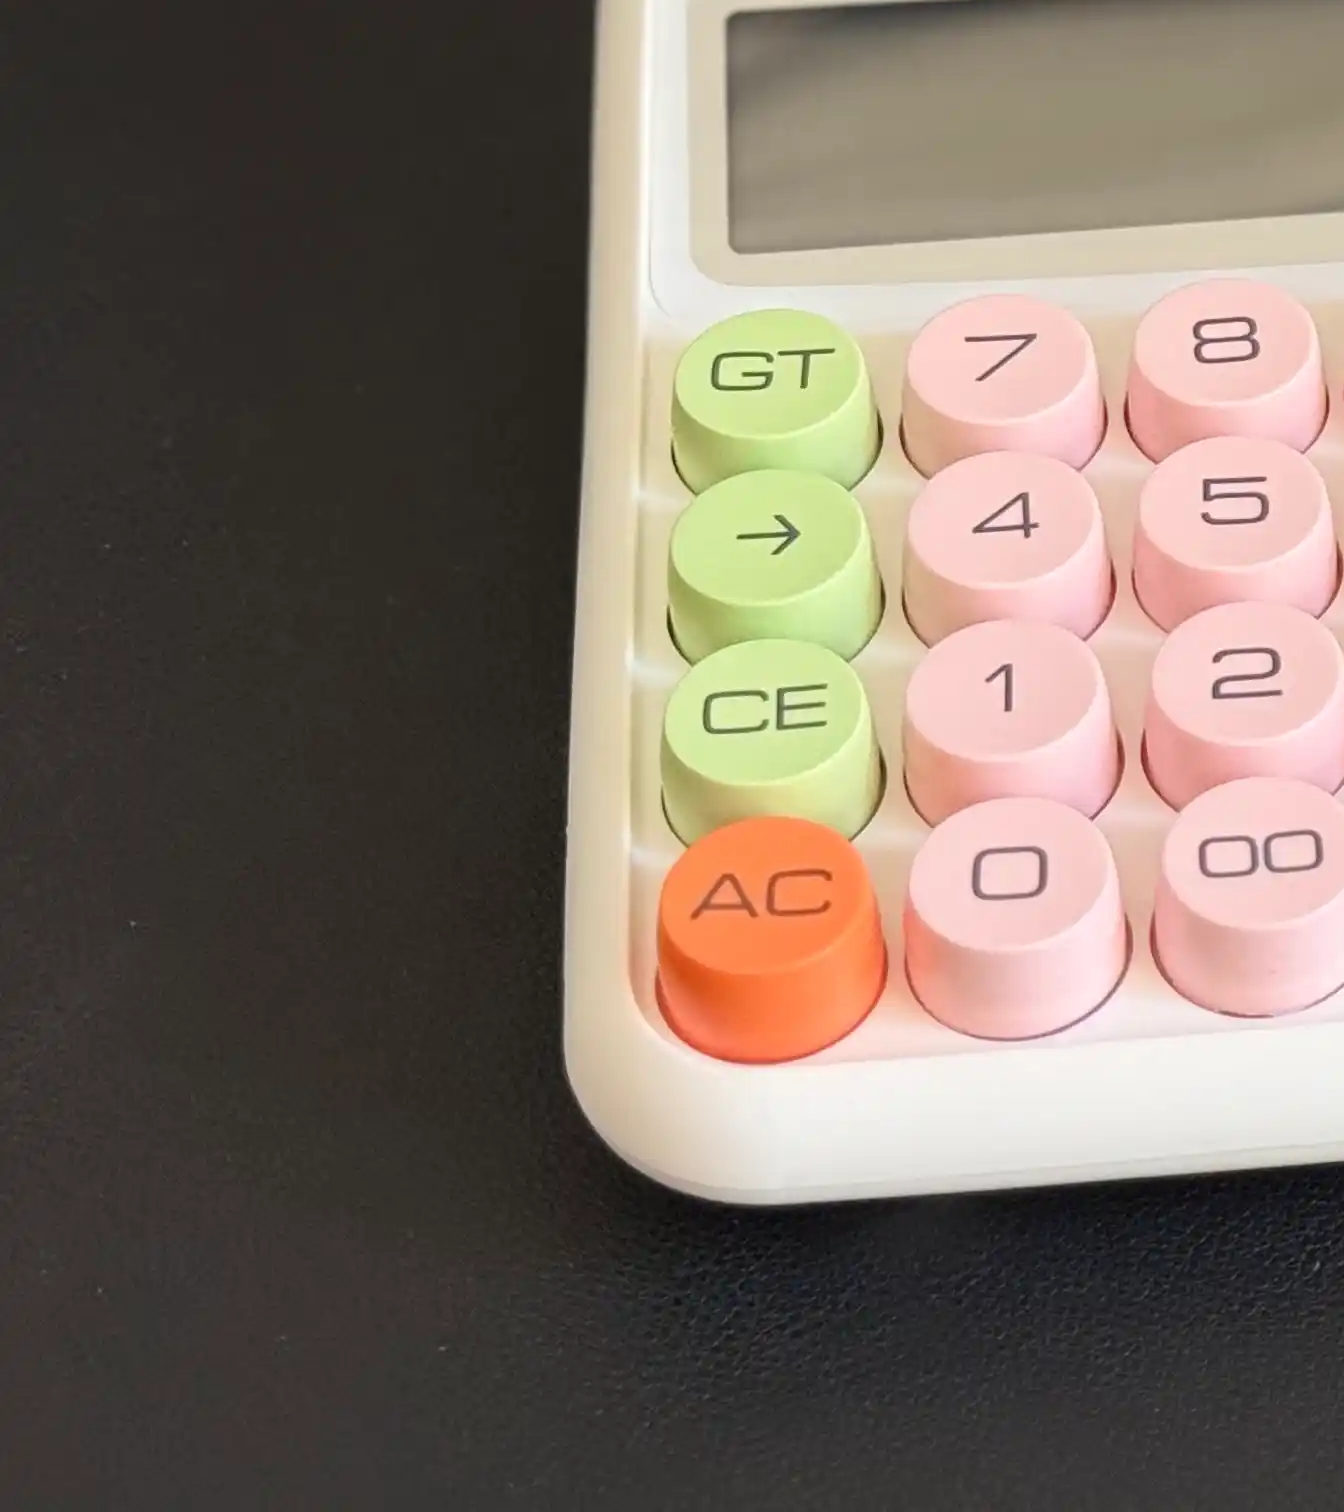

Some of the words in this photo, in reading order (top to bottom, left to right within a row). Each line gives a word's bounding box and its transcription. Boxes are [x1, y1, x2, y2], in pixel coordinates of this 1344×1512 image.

[964, 333, 1038, 382] 7
[1192, 316, 1261, 365] 8
[710, 347, 836, 392] GT
[971, 491, 1040, 539] 4
[1200, 476, 1270, 526] 5
[984, 663, 1015, 713] 1
[1211, 647, 1283, 700] 2
[701, 683, 828, 735] CE
[971, 845, 1049, 901] 0
[1198, 829, 1324, 879] 00
[690, 868, 833, 921] AC
